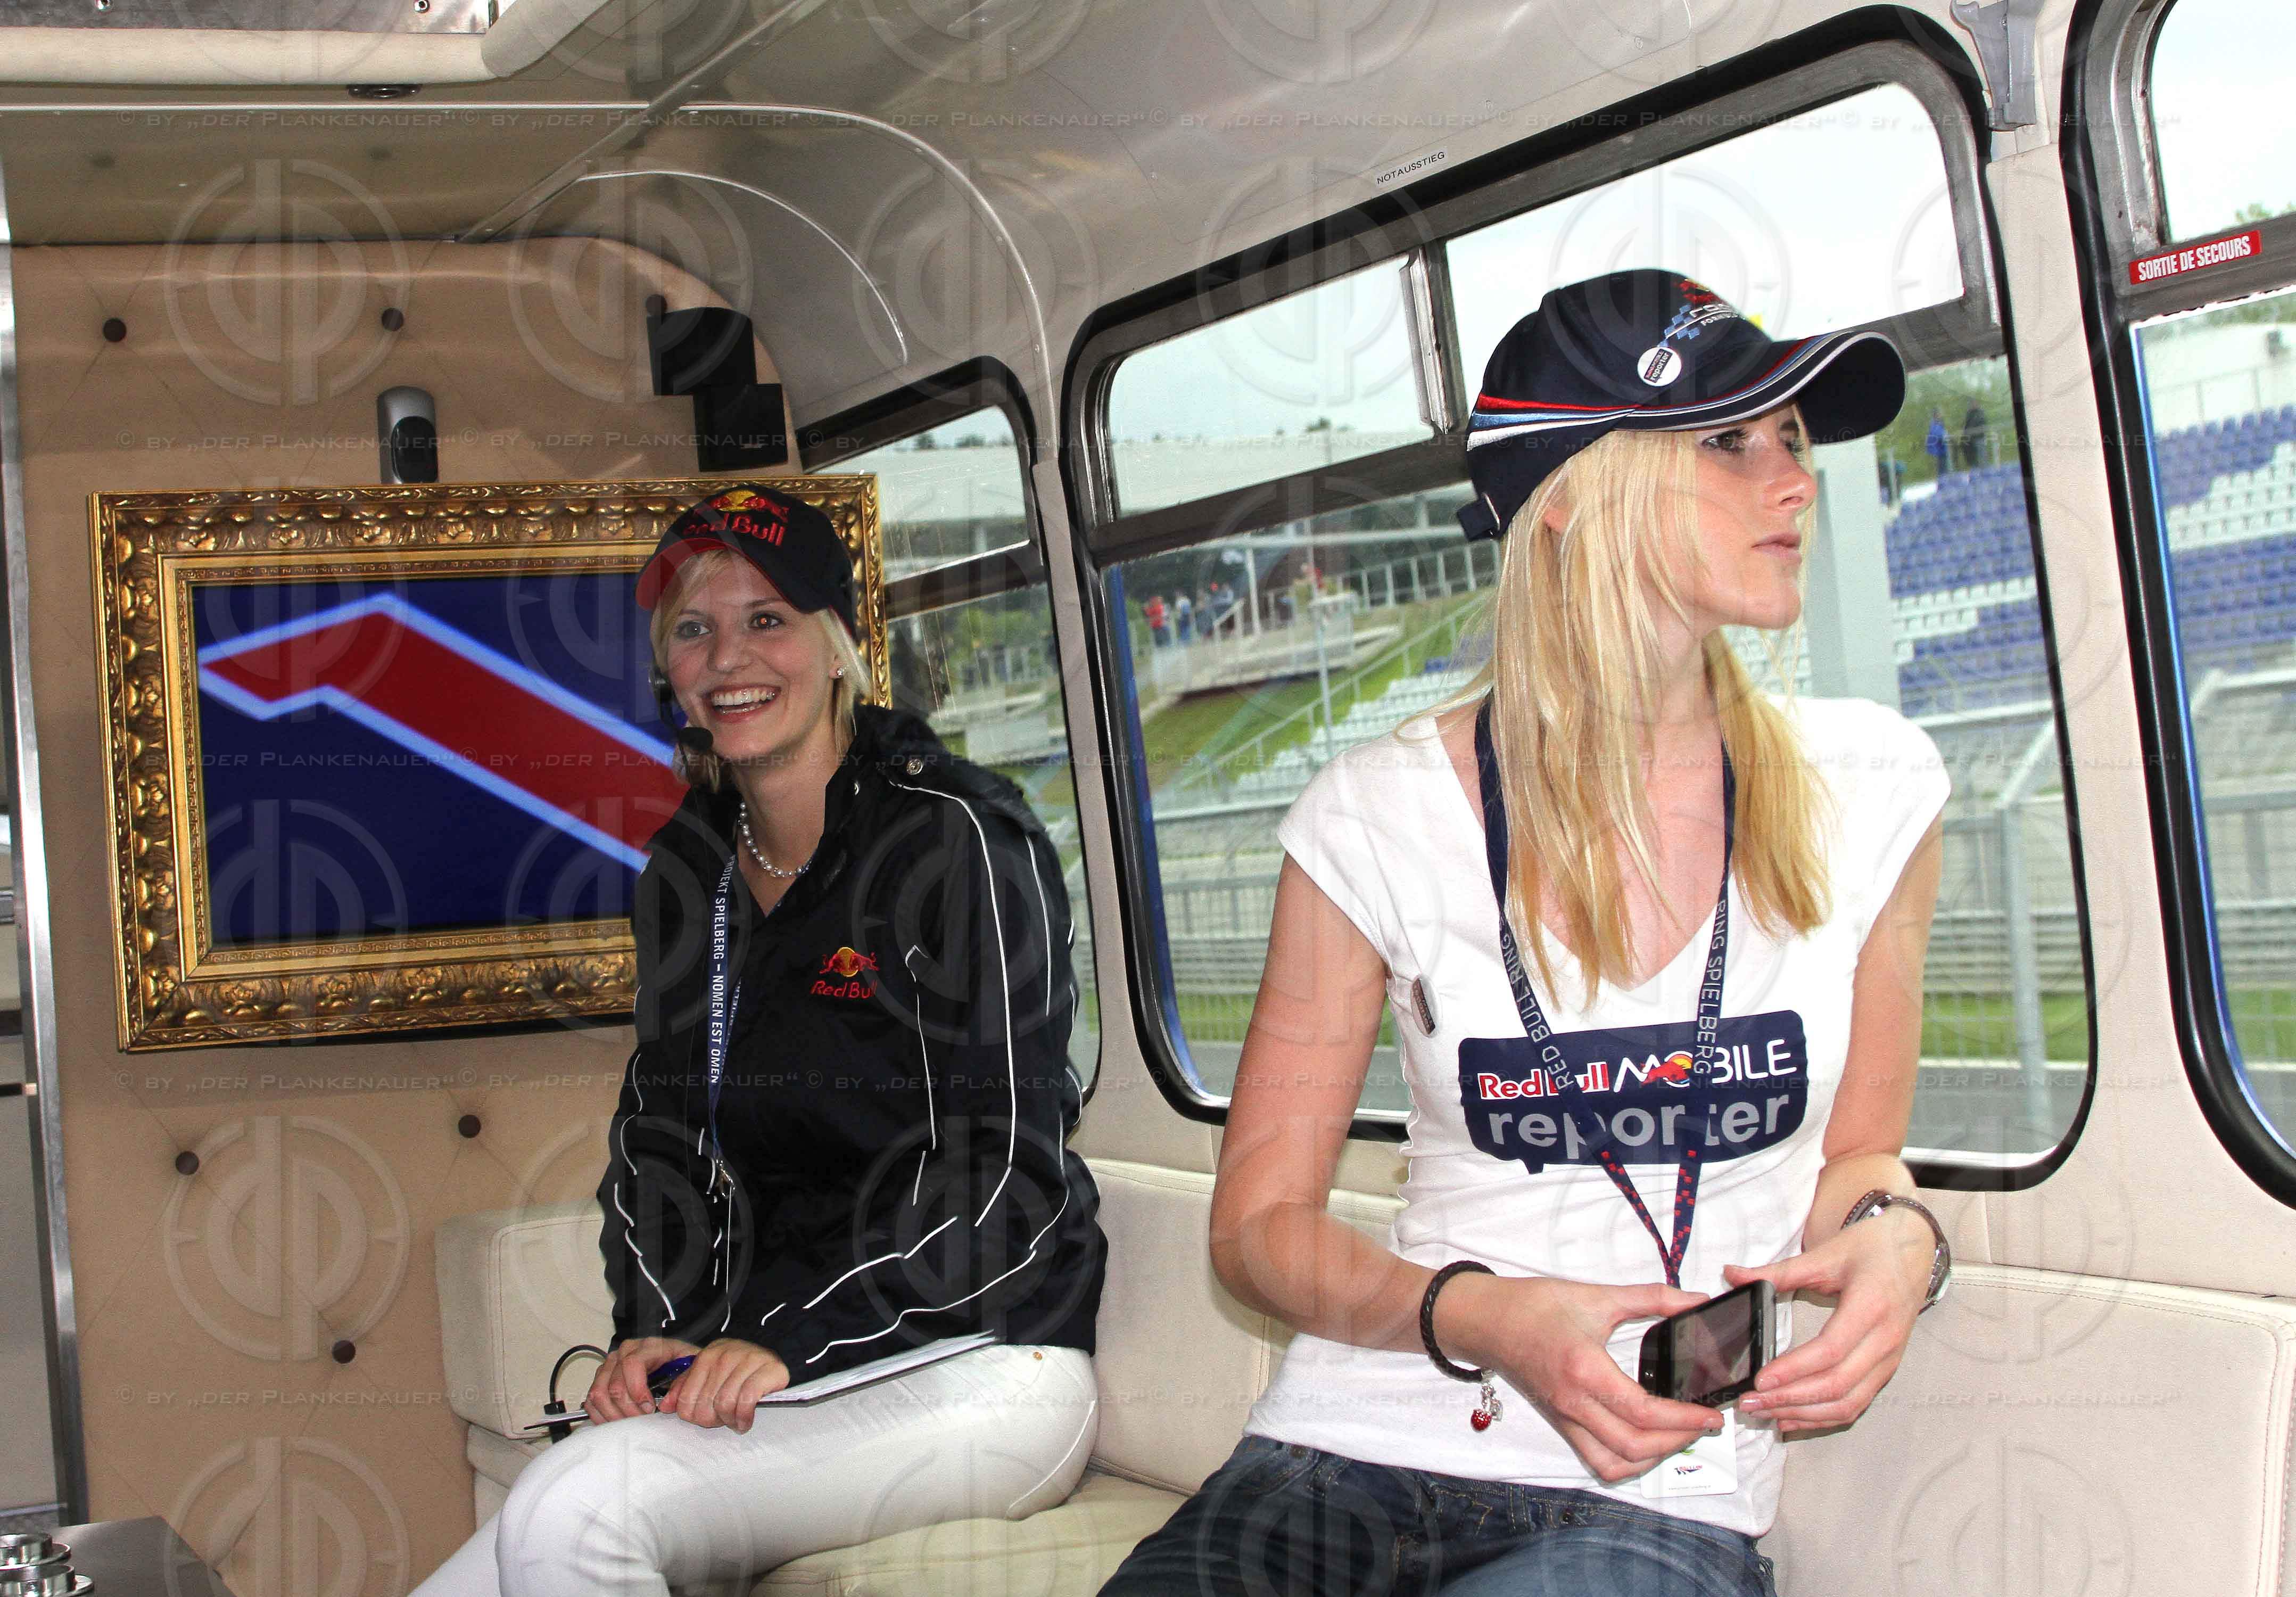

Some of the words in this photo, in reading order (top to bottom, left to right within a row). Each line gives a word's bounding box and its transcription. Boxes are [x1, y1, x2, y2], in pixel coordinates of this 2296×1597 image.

[1377, 152, 1445, 184] NOTAUSSTIEG
[2137, 254, 2178, 281] SORTIE
[2179, 250, 2196, 272] DE
[2196, 235, 2251, 267] SECOURS
[731, 514, 786, 546] Bull
[714, 898, 725, 959] SPIELBERG
[712, 975, 724, 1017] NOMEN
[810, 980, 848, 997] Red
[847, 979, 878, 999] Bull
[712, 1022, 723, 1045] EST
[1517, 986, 1551, 1043] BULL
[1693, 956, 1723, 1075] SPIELBERG
[711, 1049, 721, 1083] OMEN
[1477, 1068, 1543, 1100] Red
[1542, 1046, 1574, 1091] RED
